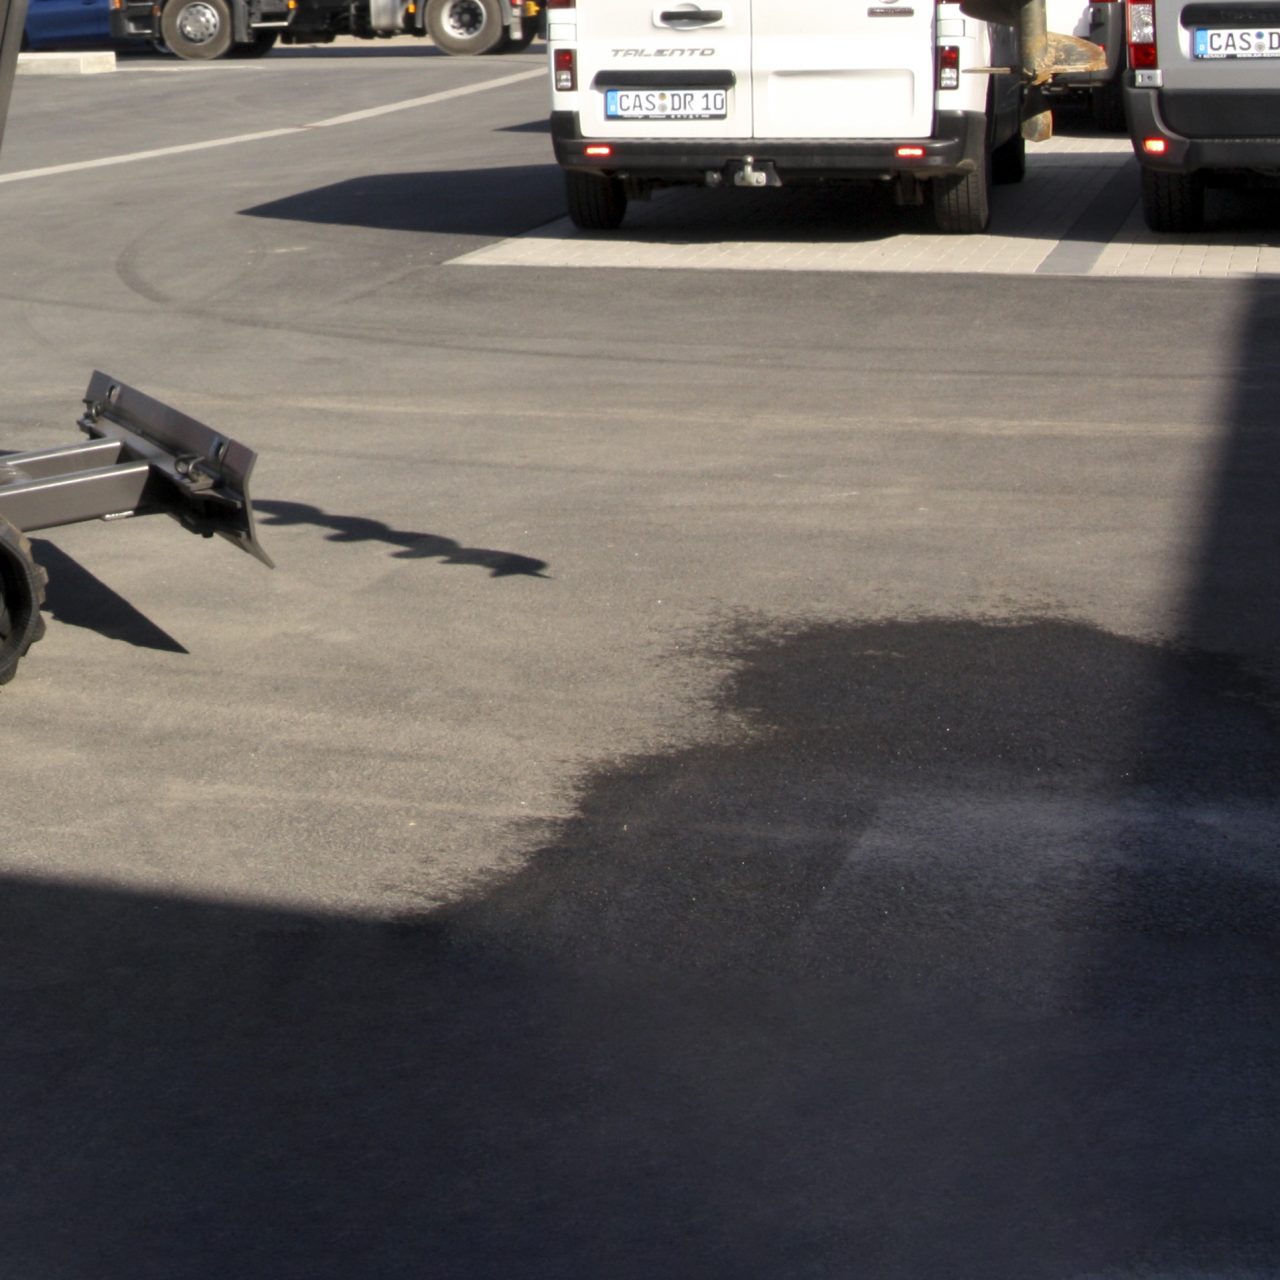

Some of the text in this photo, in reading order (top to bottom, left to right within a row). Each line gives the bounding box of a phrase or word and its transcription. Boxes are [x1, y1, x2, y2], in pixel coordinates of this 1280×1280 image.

[1209, 31, 1252, 51] CAS
[611, 48, 716, 57] TALENTO
[619, 93, 656, 112] CAS
[670, 93, 695, 112] DR
[701, 92, 725, 111] 10
